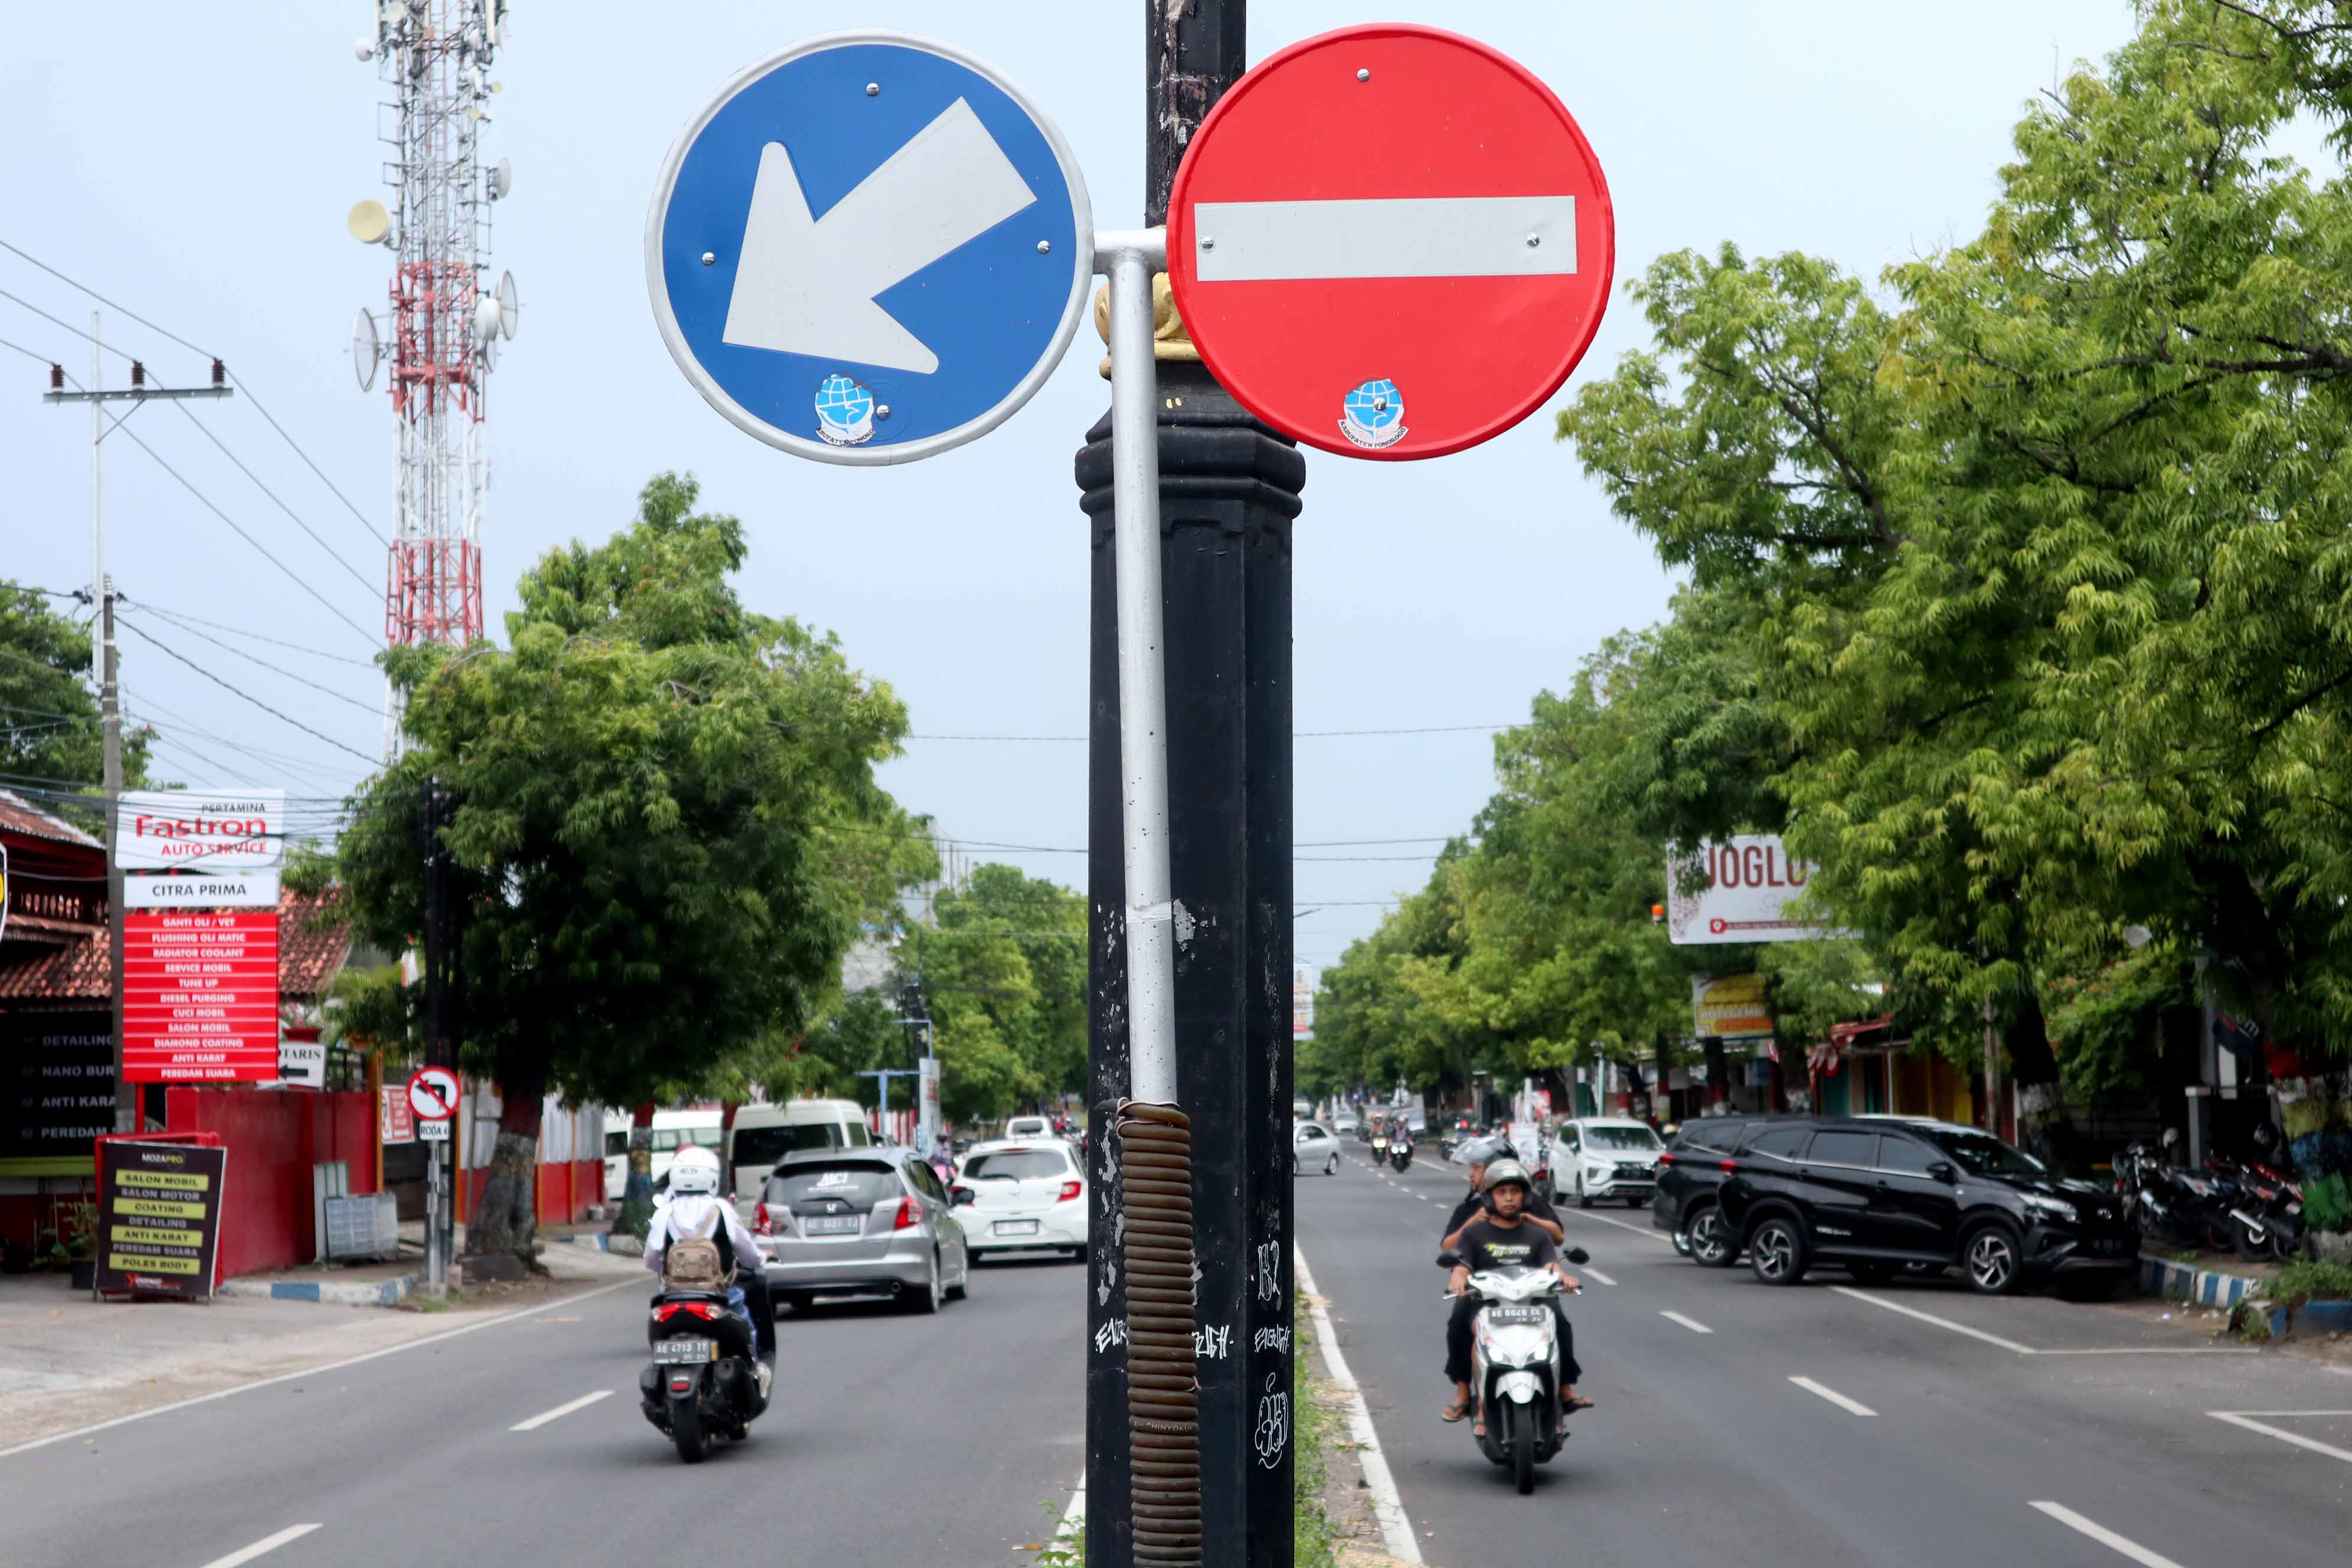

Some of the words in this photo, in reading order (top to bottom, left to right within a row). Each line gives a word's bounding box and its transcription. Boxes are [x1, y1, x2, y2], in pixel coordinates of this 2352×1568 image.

[1339, 420, 1373, 448] KABUPATEN
[1374, 427, 1406, 448] PONOROGO
[136, 815, 267, 838] Fastron
[161, 842, 204, 857] AUTO
[152, 884, 194, 897] CITRA
[199, 884, 247, 896] PRIMA
[163, 918, 192, 927] GANTI
[152, 933, 198, 943] FLUSHING
[218, 933, 246, 943] MATIC
[153, 948, 199, 958] RADIATOR
[200, 948, 244, 958] COOLANT
[202, 963, 232, 973] MOBIL
[205, 979, 218, 988] UP
[172, 1008, 194, 1017] CUCI
[196, 1008, 225, 1017] MOBIL
[201, 1023, 230, 1033] MOBIL
[172, 1054, 194, 1063] ANTI
[42, 1066, 82, 1077] NANO
[161, 1069, 203, 1078] PEREDAM
[205, 1069, 236, 1077] SUARA
[41, 1096, 75, 1108] ANTI
[420, 1126, 441, 1135] RODA
[125, 1174, 161, 1184] SALON
[164, 1177, 198, 1187] MOBIL
[121, 1187, 158, 1198] SALON
[160, 1191, 200, 1201] MOTOR
[129, 1216, 187, 1229] DETAILING
[124, 1230, 149, 1239] ANTI
[113, 1243, 161, 1254] PEREDAM
[163, 1246, 198, 1257] SUARA
[159, 1260, 190, 1270] BODY
